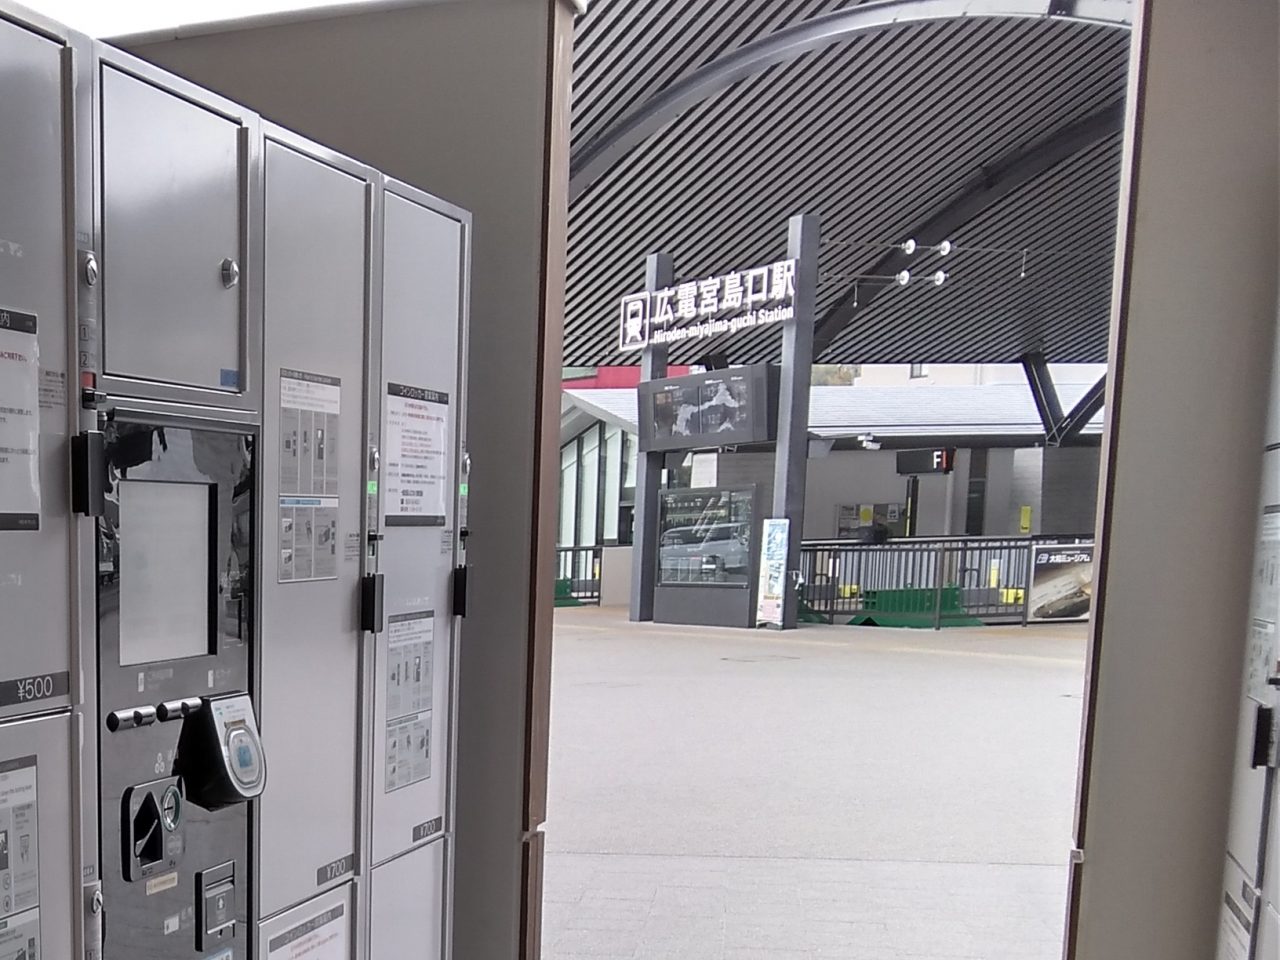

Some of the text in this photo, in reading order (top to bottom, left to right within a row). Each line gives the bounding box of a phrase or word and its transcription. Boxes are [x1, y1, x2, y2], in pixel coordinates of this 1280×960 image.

[651, 259, 796, 324] 広電宮島口駅
[757, 305, 794, 324] Station
[17, 676, 53, 700] ¥500
